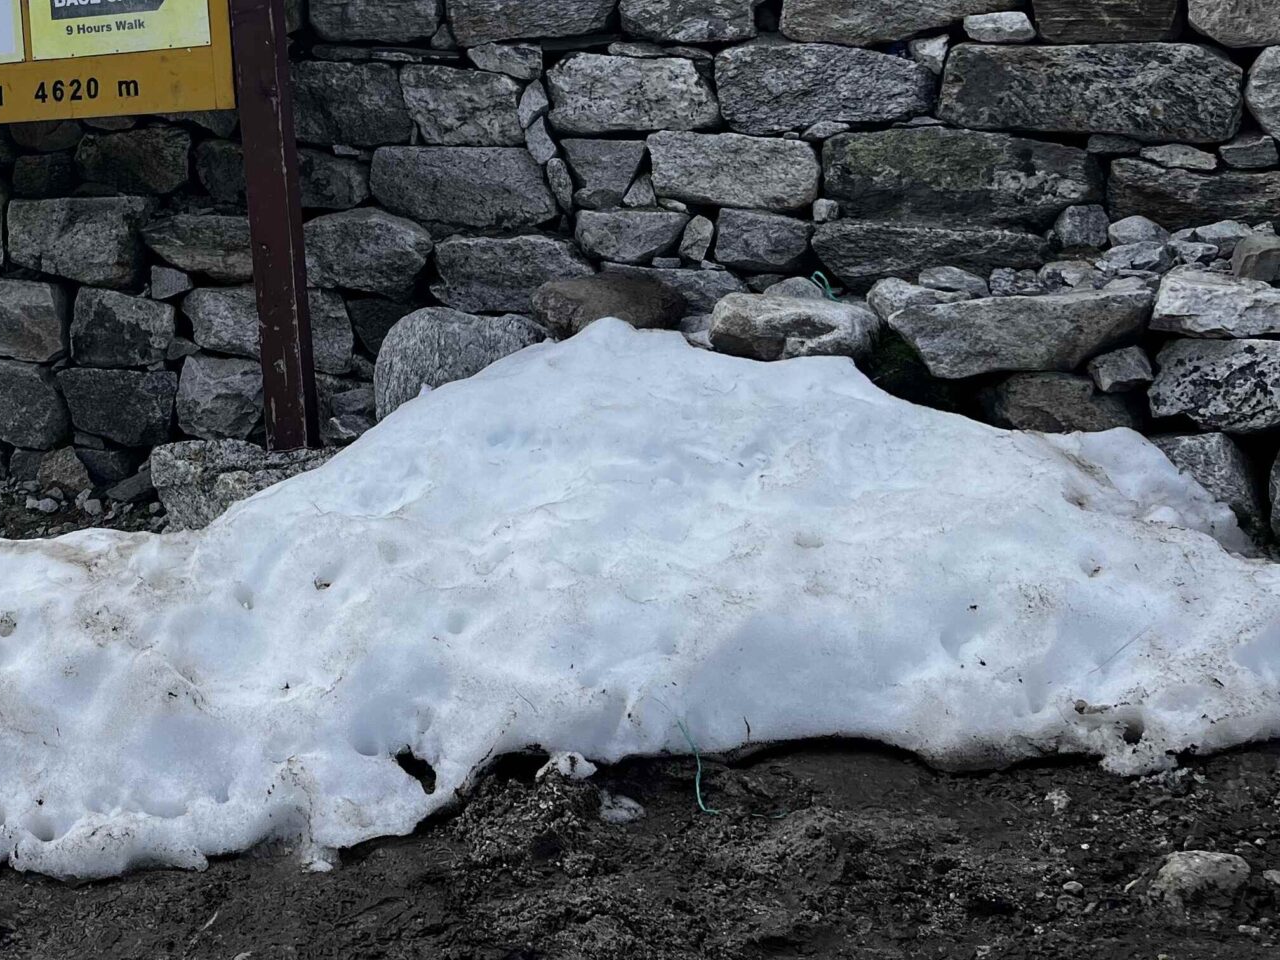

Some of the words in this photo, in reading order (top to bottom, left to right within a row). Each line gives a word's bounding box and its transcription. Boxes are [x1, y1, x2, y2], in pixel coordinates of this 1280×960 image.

[66, 25, 73, 35] 9
[77, 22, 112, 35] Hours
[115, 19, 146, 31] Walk
[34, 77, 99, 104] 4620
[117, 79, 139, 97] m
